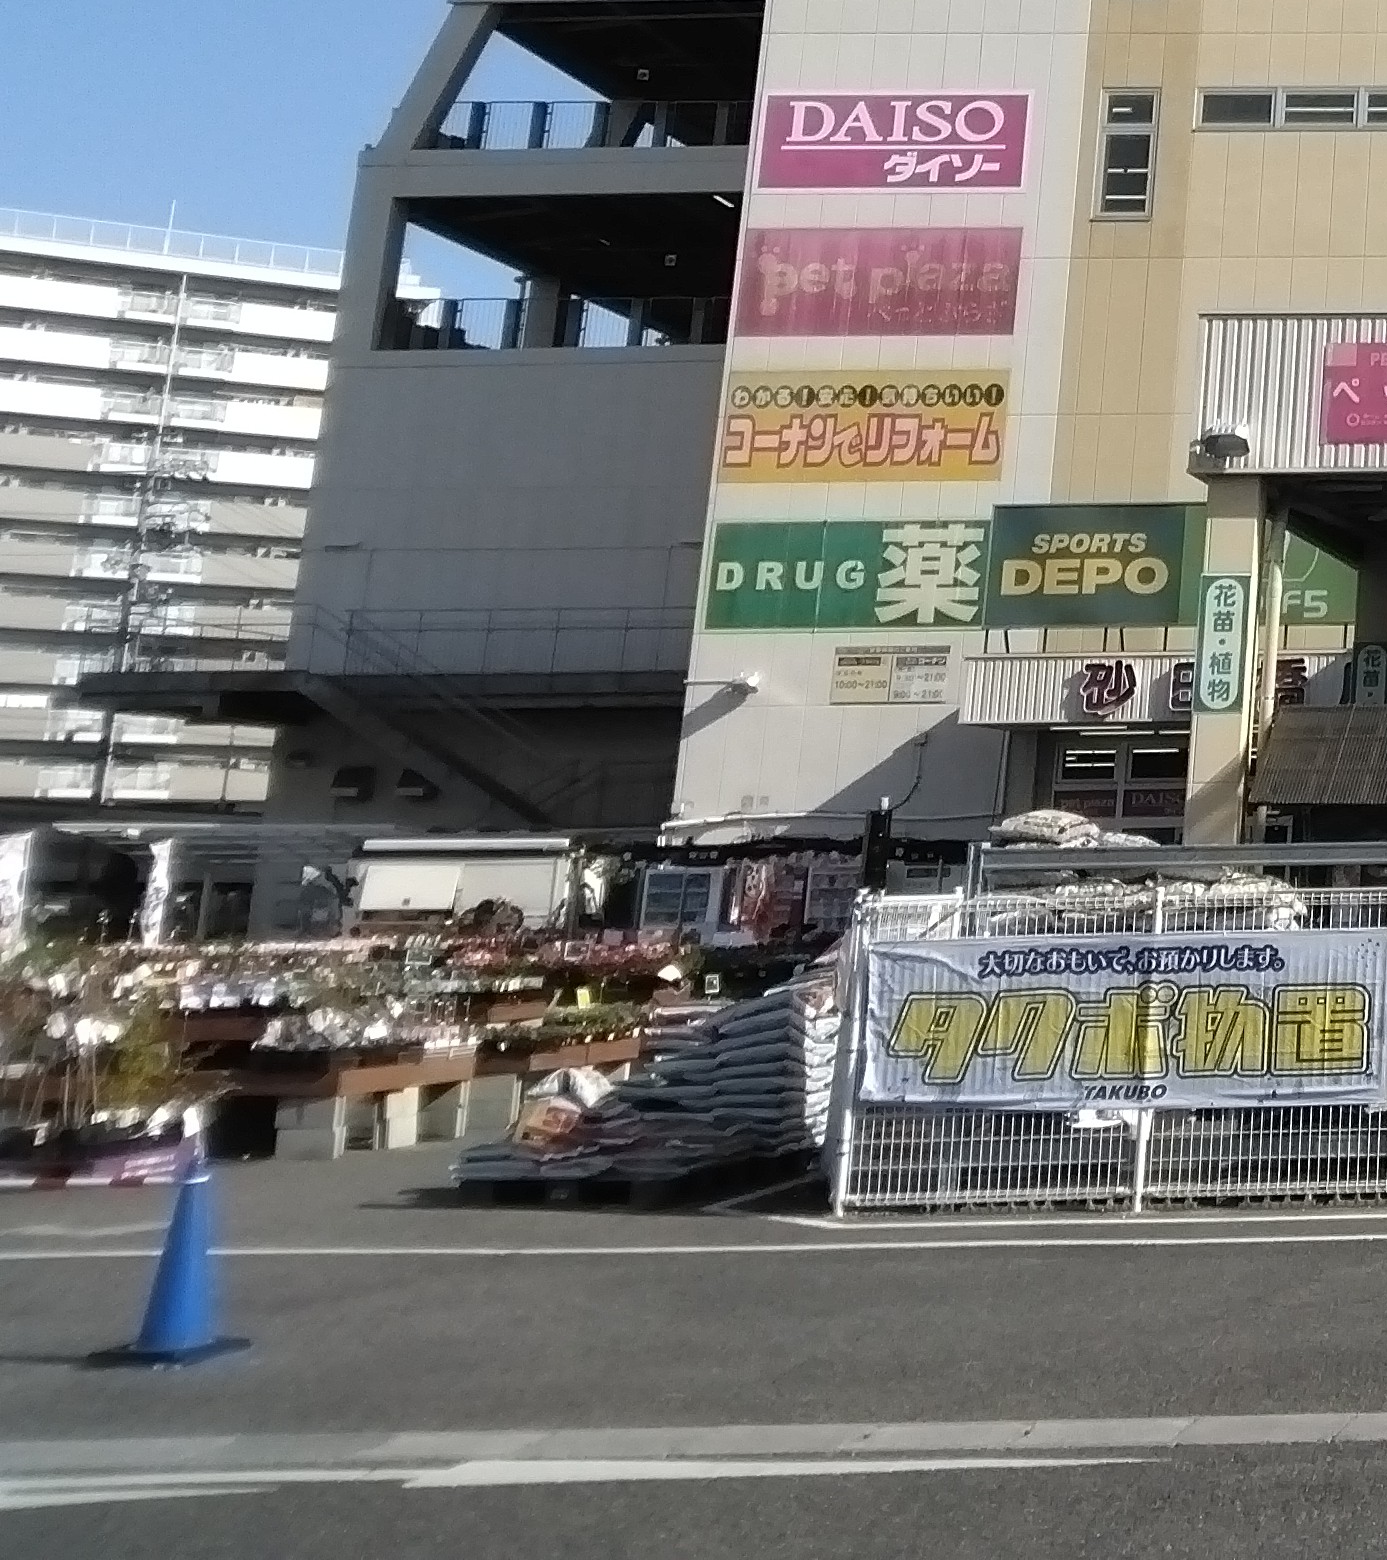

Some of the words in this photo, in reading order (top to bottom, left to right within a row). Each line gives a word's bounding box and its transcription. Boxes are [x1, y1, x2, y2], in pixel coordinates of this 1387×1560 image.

[786, 100, 1005, 142] DAISO
[883, 152, 1000, 183] ダイソー
[758, 245, 856, 317] pet
[722, 412, 1000, 468] コーナンでリフォーム
[1032, 533, 1148, 555] SPORTS
[716, 560, 865, 590] DRUG
[874, 524, 985, 623] 薬
[1000, 558, 1169, 597] DEPO
[1208, 584, 1237, 703] 花苗・植物
[979, 945, 1286, 979] 大切なおもいで、お預かりします。
[888, 981, 1371, 1084] タクボ物置
[1082, 1083, 1168, 1101] TAKUBO
